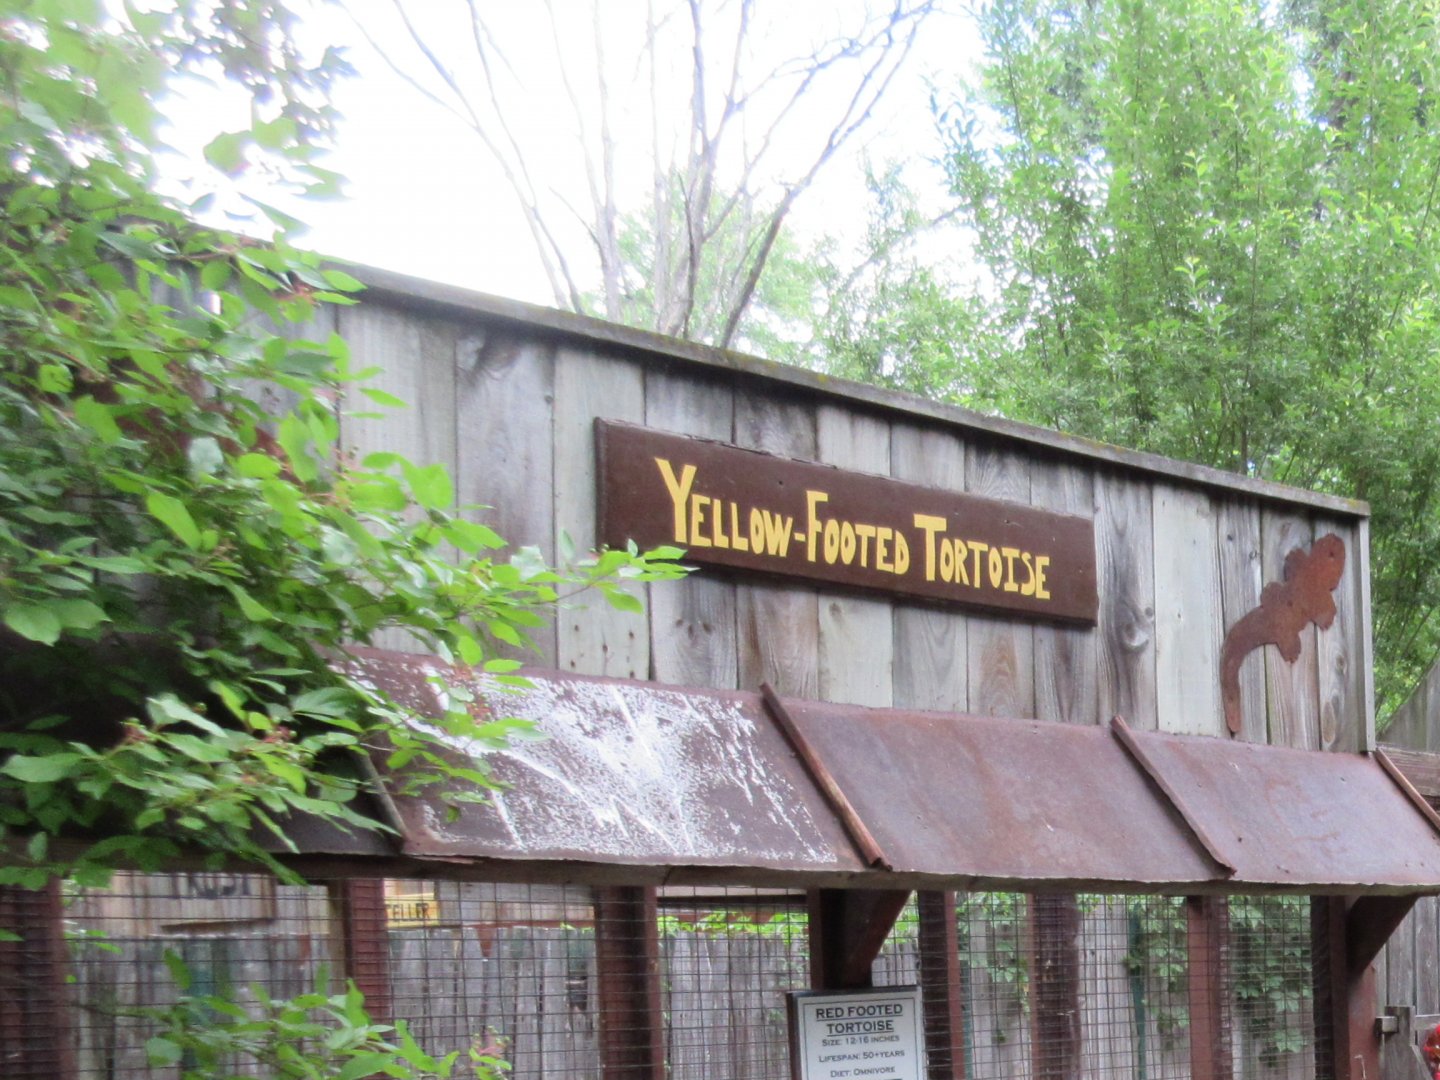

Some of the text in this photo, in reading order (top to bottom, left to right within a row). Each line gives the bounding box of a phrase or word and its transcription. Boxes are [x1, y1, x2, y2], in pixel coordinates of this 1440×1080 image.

[654, 456, 1051, 600] YELLOW-FOOTED TORTOISE
[815, 1003, 903, 1020] RED FOOTED
[826, 1020, 894, 1034] TORTOISE
[871, 1035, 900, 1043] INCHES
[853, 1066, 896, 1076] OMNIVORE
